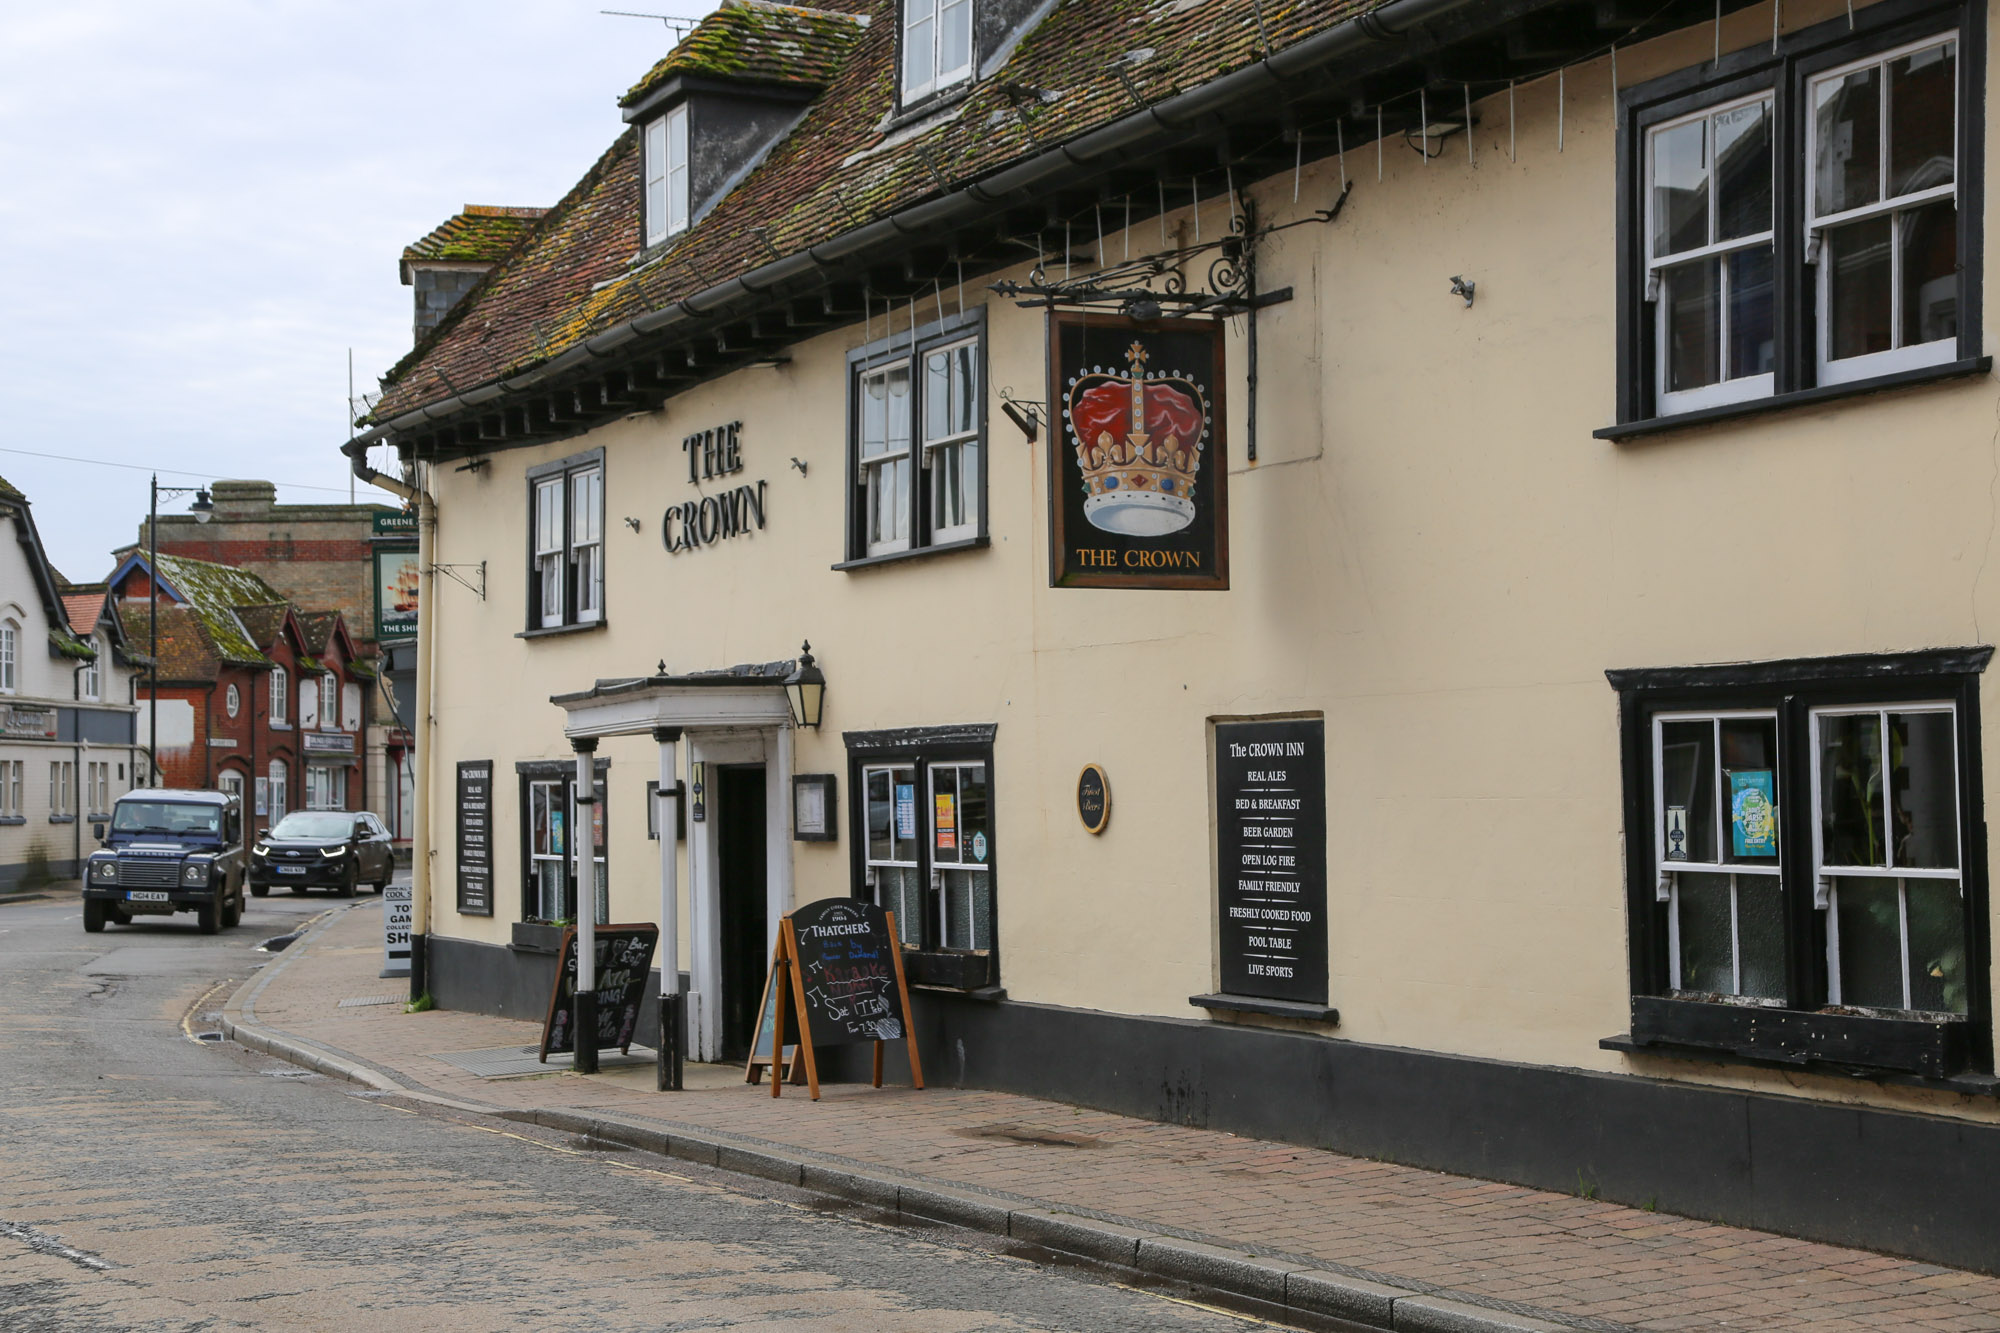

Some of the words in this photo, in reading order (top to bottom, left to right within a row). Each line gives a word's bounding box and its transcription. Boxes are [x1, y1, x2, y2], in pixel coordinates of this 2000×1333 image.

[682, 420, 743, 484] THE
[380, 518, 413, 526] GREENE
[661, 479, 768, 553] CROWN
[1076, 549, 1118, 567] THE
[1124, 549, 1201, 568] CROWN
[383, 625, 400, 633] THE
[1229, 742, 1247, 757] The
[1248, 742, 1284, 757] CROWN
[1286, 742, 1305, 756] INN
[1247, 771, 1267, 782] REAL
[1267, 770, 1287, 781] ALES
[1235, 799, 1250, 809] BED
[1251, 799, 1258, 809] &
[1258, 799, 1301, 810] BREAKFAST
[1243, 827, 1262, 837] BEER
[1263, 827, 1293, 838] GARDEN
[1242, 854, 1261, 865] OPEN
[1262, 855, 1277, 866] LOG
[1278, 855, 1296, 867] FIRE
[1238, 879, 1264, 891] FAMILY
[1265, 881, 1301, 893] FRIENDLY
[151, 892, 166, 900] EAY
[1229, 907, 1260, 919] FRESHLY
[1261, 908, 1290, 921] COOKED
[1291, 911, 1312, 922] FOOD
[811, 921, 871, 938] THATCHERS
[387, 932, 412, 944] SH
[628, 936, 649, 950] Bar
[1248, 936, 1268, 948] POOL
[1268, 937, 1292, 949] TABLE
[1248, 963, 1265, 976] LIVE
[1265, 965, 1294, 978] SPORTS
[824, 997, 850, 1021] Sat
[869, 998, 882, 1014] Feb
